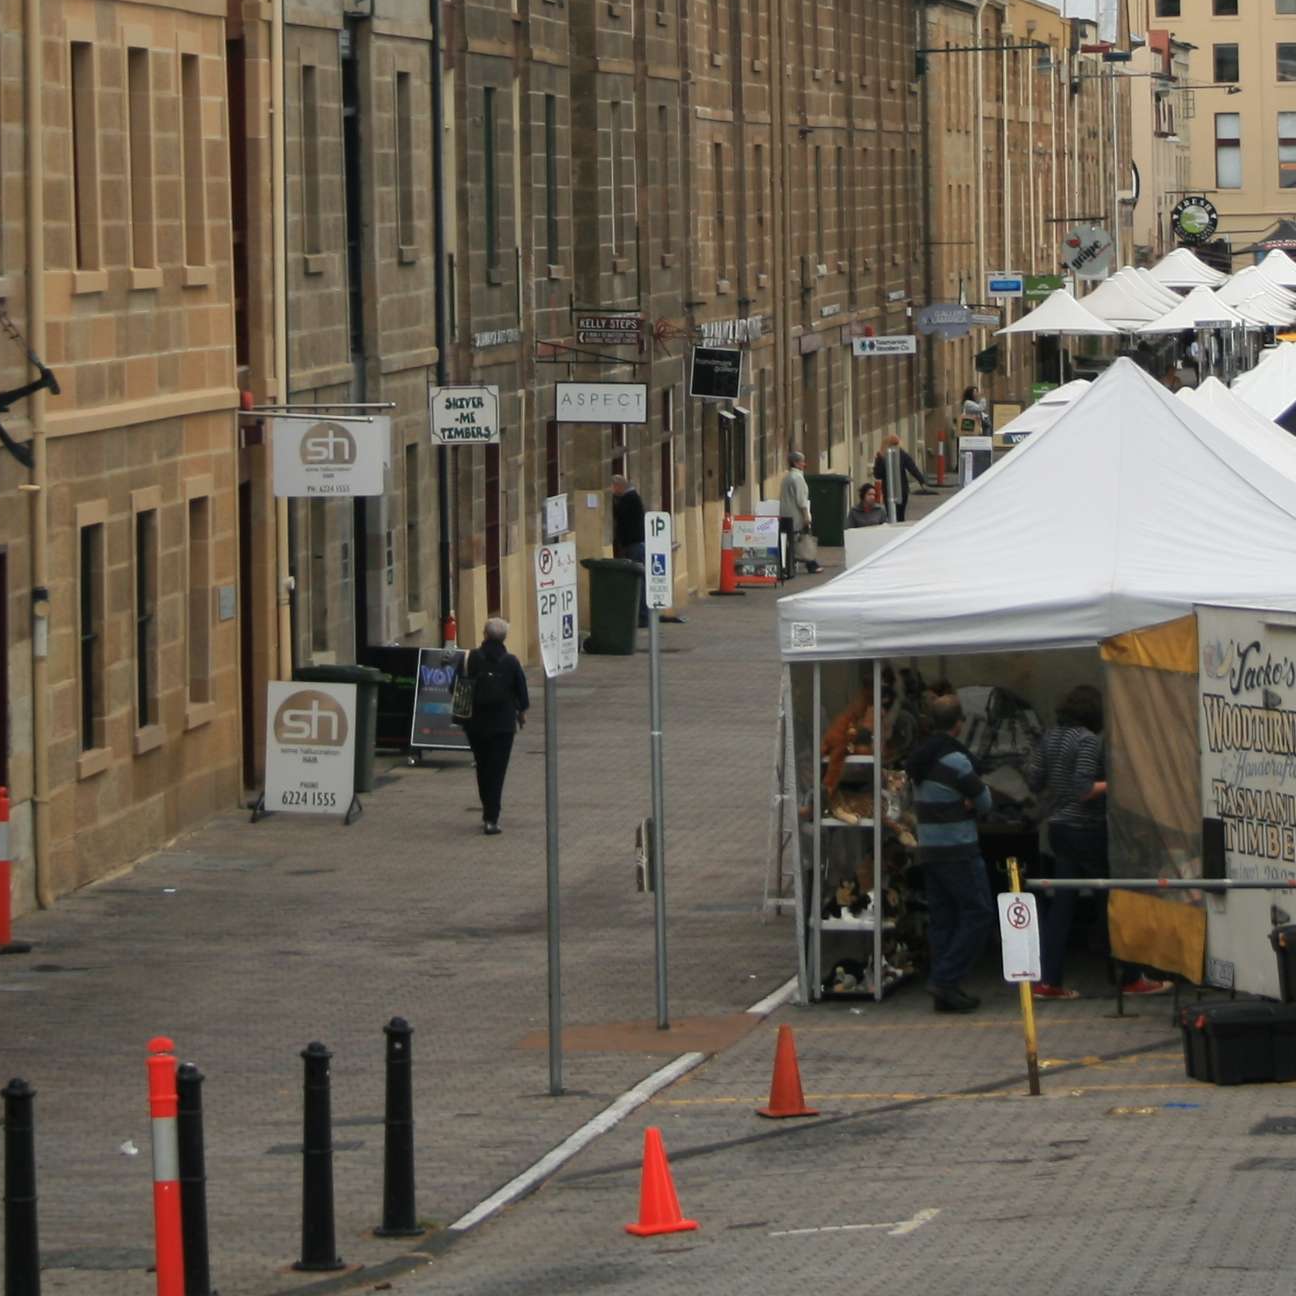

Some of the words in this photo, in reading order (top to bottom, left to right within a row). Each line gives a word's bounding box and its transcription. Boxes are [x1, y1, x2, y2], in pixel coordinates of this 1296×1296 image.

[579, 318, 608, 329] KELLY
[609, 318, 638, 329] STEPS
[444, 396, 485, 410] SHIVER
[561, 393, 643, 406] ASPECT
[440, 426, 492, 440] TIMBERS
[540, 593, 558, 615] 2P
[560, 590, 573, 612] 1P
[1230, 640, 1296, 694] Jacko's
[281, 790, 308, 805] 6224
[312, 791, 336, 807] 1555
